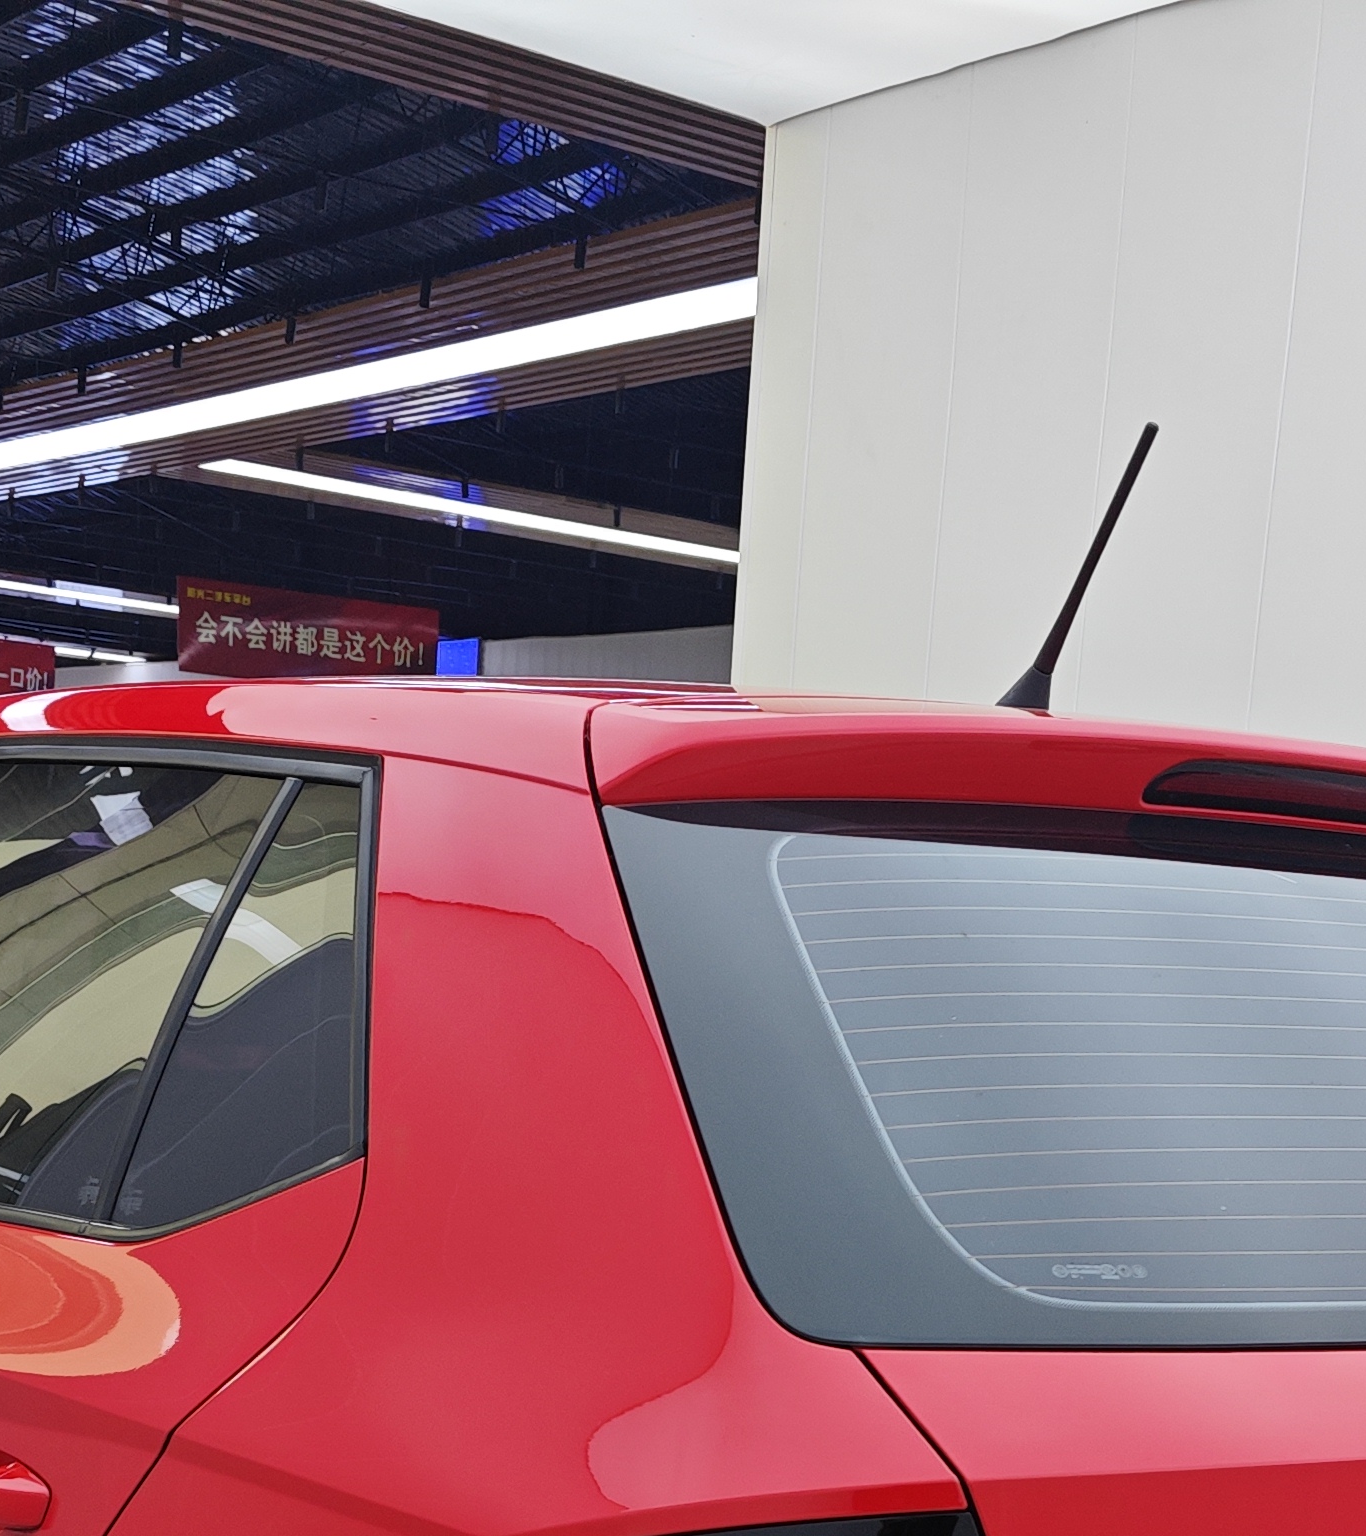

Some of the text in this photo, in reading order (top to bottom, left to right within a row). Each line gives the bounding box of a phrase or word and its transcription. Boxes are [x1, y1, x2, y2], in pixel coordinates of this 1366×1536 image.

[194, 610, 425, 669] 会不会讲都是这个价!
